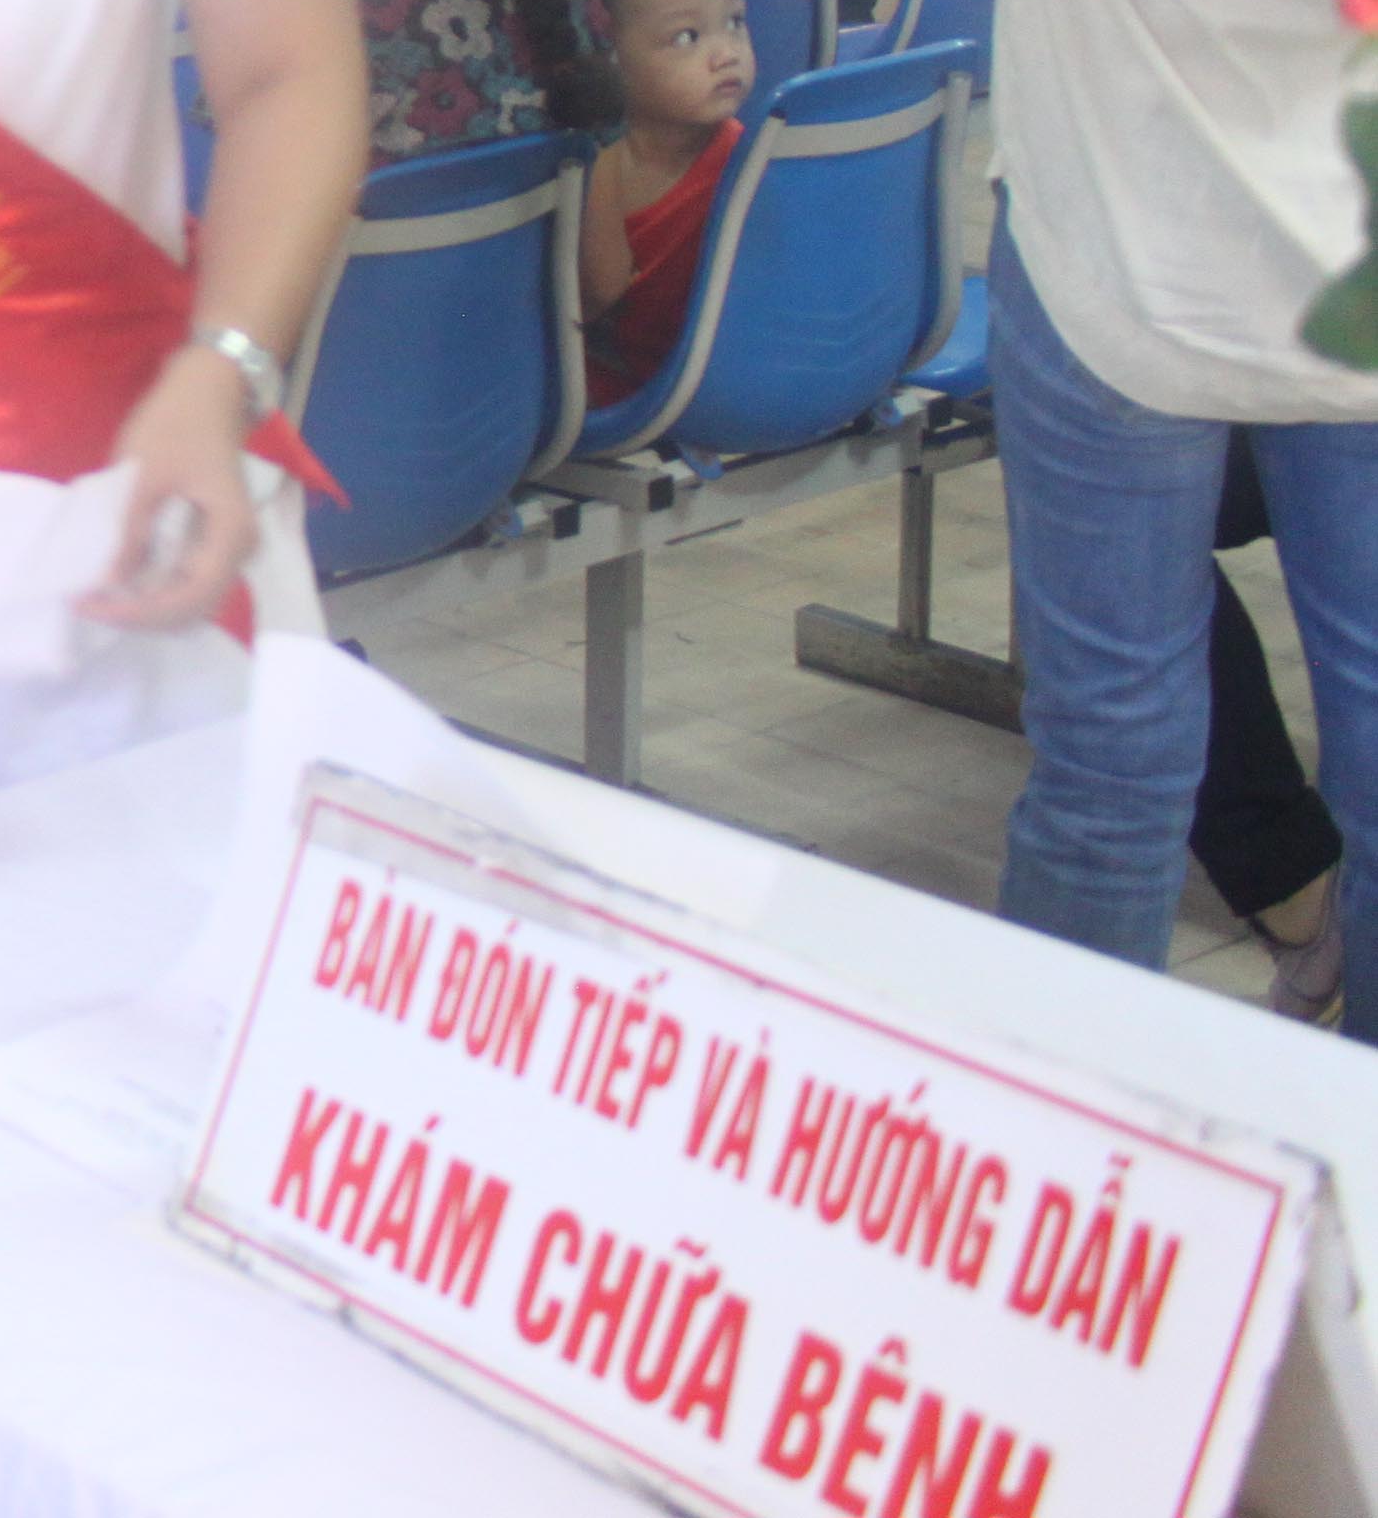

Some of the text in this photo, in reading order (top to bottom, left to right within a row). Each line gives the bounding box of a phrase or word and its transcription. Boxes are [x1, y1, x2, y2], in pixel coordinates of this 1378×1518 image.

[268, 1082, 514, 1312] KHÁM
[512, 1205, 752, 1445] CHỮA
[426, 917, 558, 1079] ĐÓN
[550, 968, 687, 1131] TIẾP
[683, 1025, 772, 1185] VÀ
[766, 1075, 1010, 1291] HƯỚNG
[1005, 1148, 1182, 1371] DẪN
